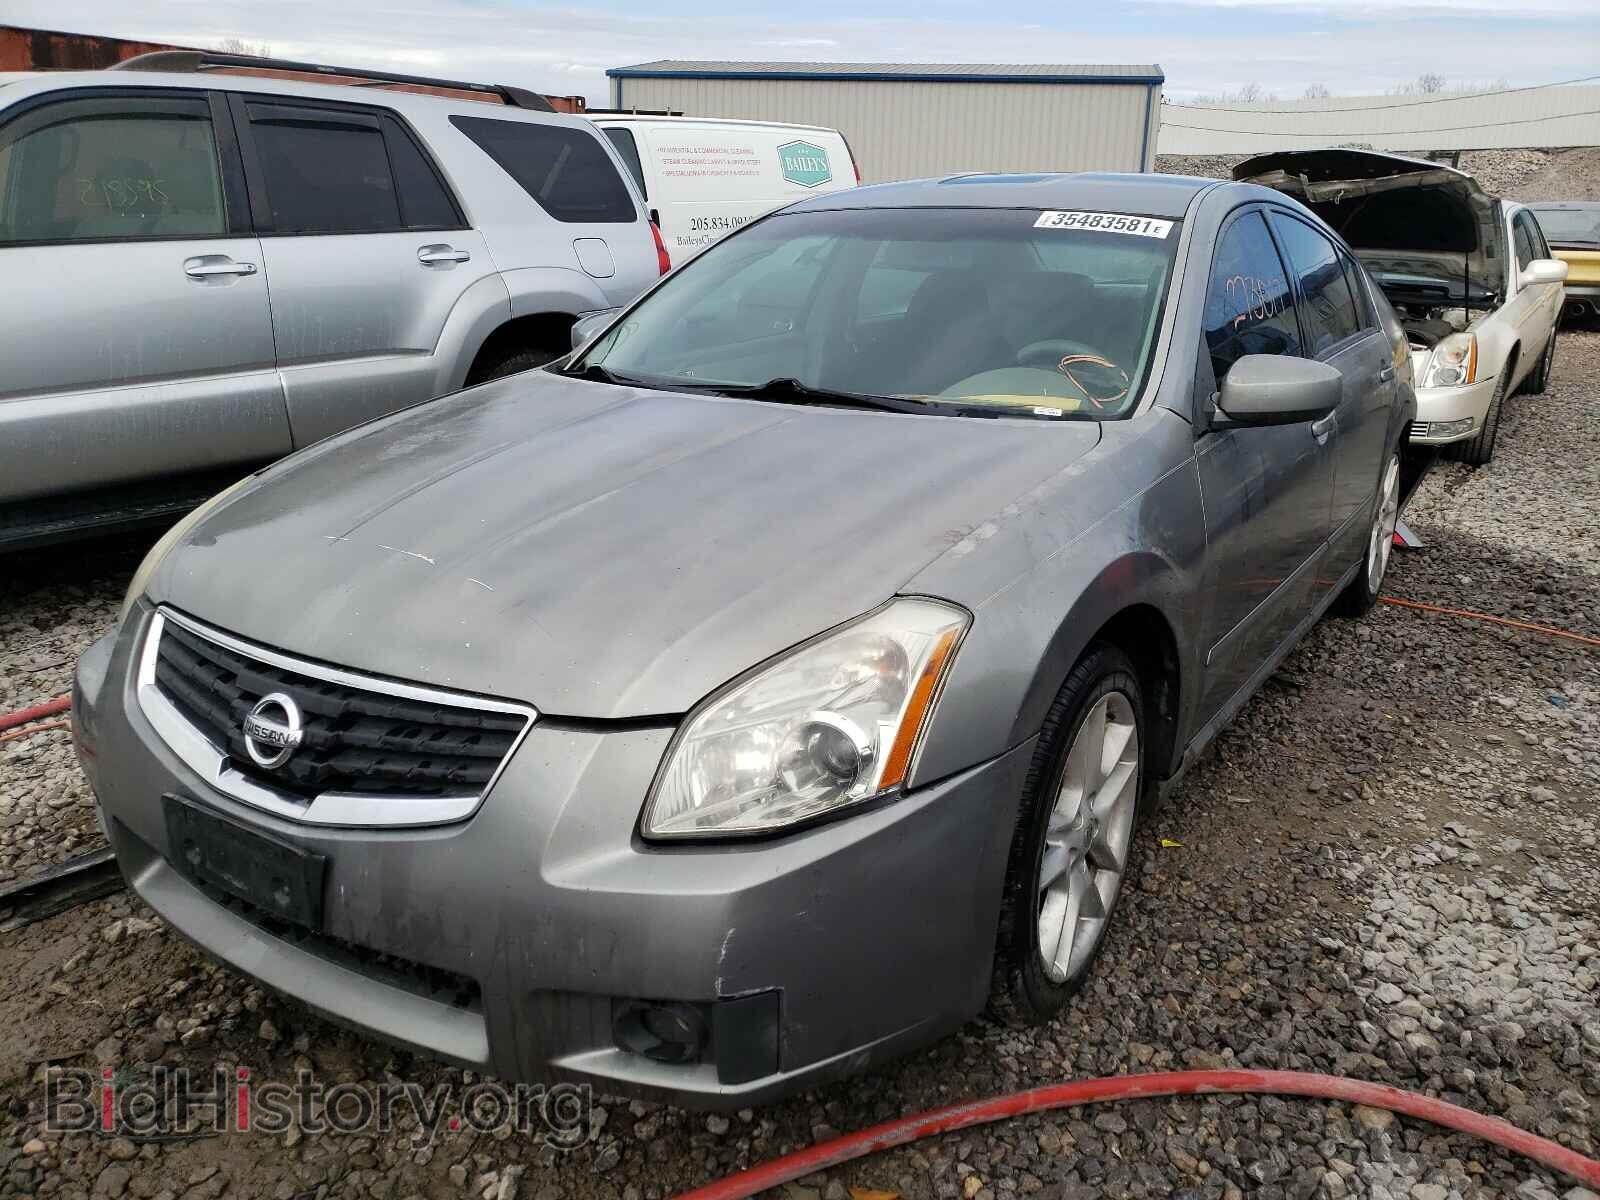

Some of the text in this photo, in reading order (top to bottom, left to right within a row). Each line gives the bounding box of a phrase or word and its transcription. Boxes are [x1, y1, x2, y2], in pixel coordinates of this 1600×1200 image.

[784, 156, 827, 172] BAILEY'S
[1051, 213, 1153, 233] 35483581
[1153, 226, 1163, 234] E
[246, 717, 292, 746] NISSAN
